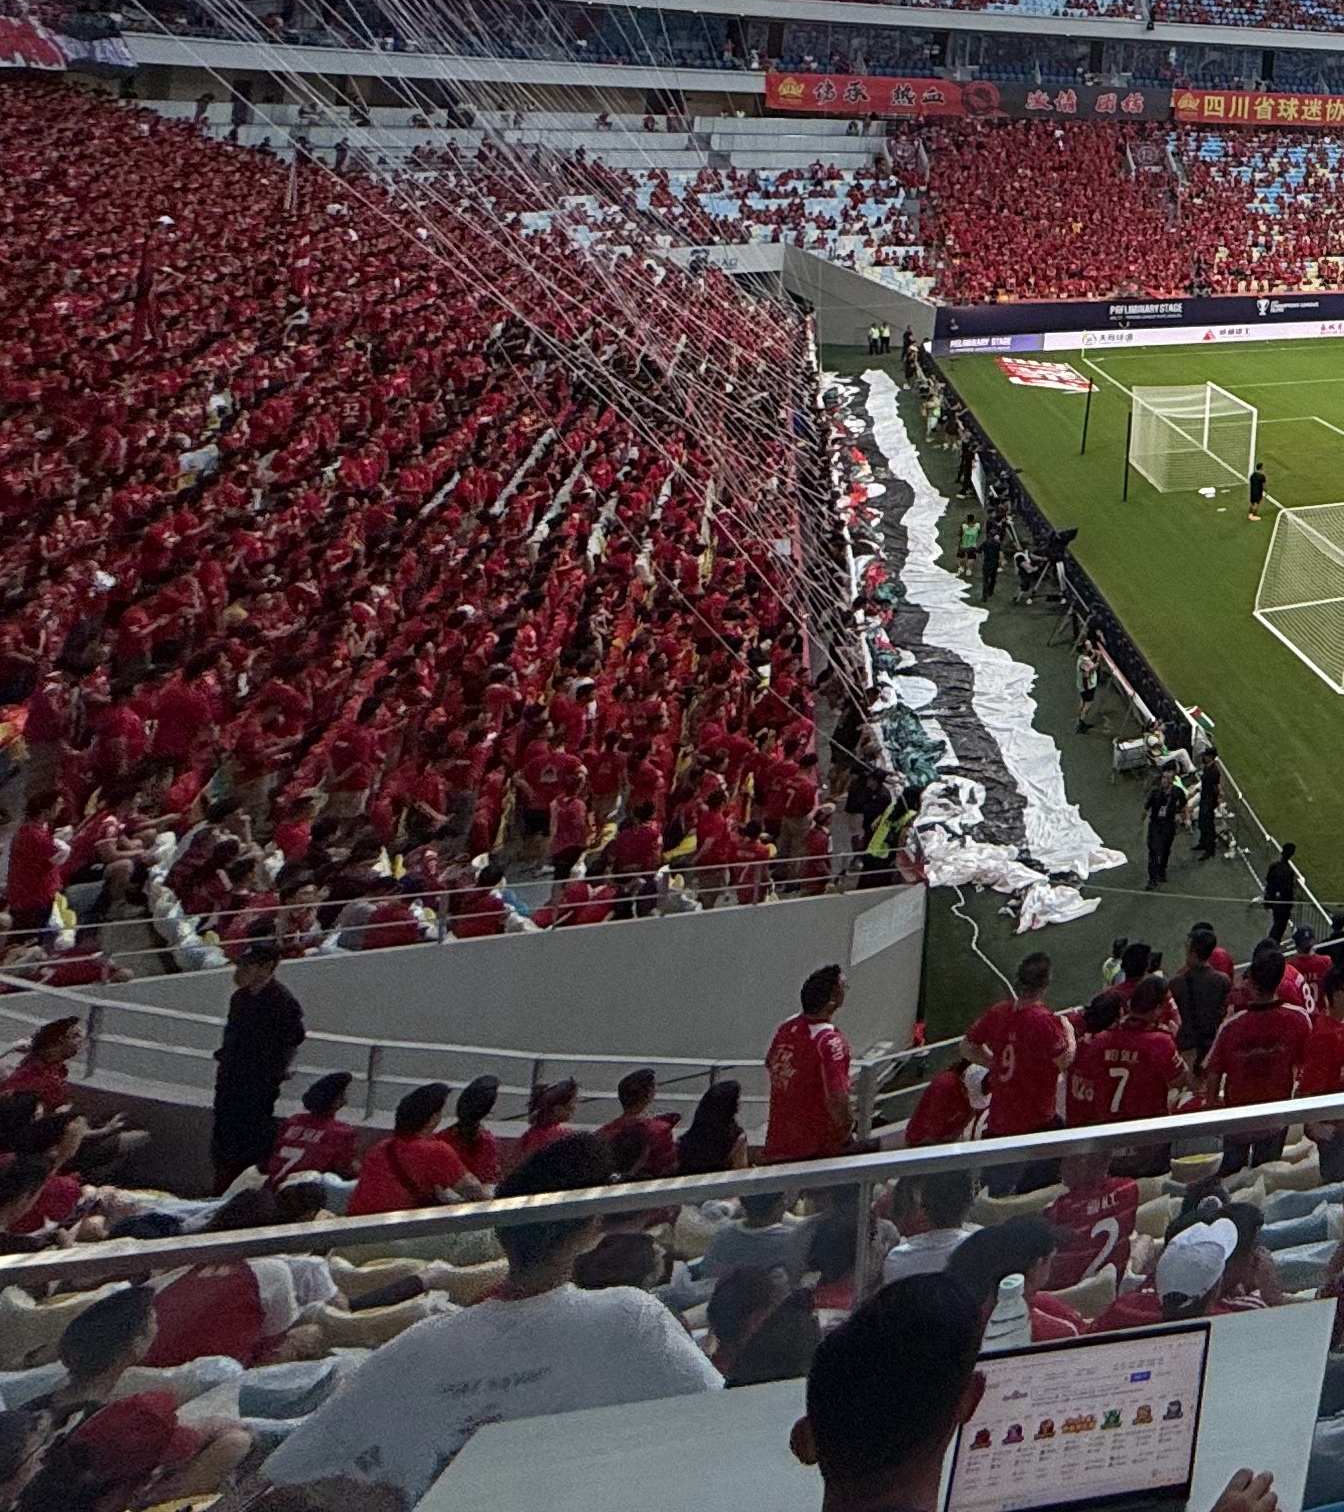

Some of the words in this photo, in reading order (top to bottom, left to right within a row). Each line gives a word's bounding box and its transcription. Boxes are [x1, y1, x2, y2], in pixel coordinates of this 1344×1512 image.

[1302, 982, 1316, 1014] 8
[1001, 1044, 1016, 1083] 9
[1108, 1067, 1130, 1113] 7
[273, 1145, 306, 1183] 7
[1081, 1215, 1120, 1279] 2
